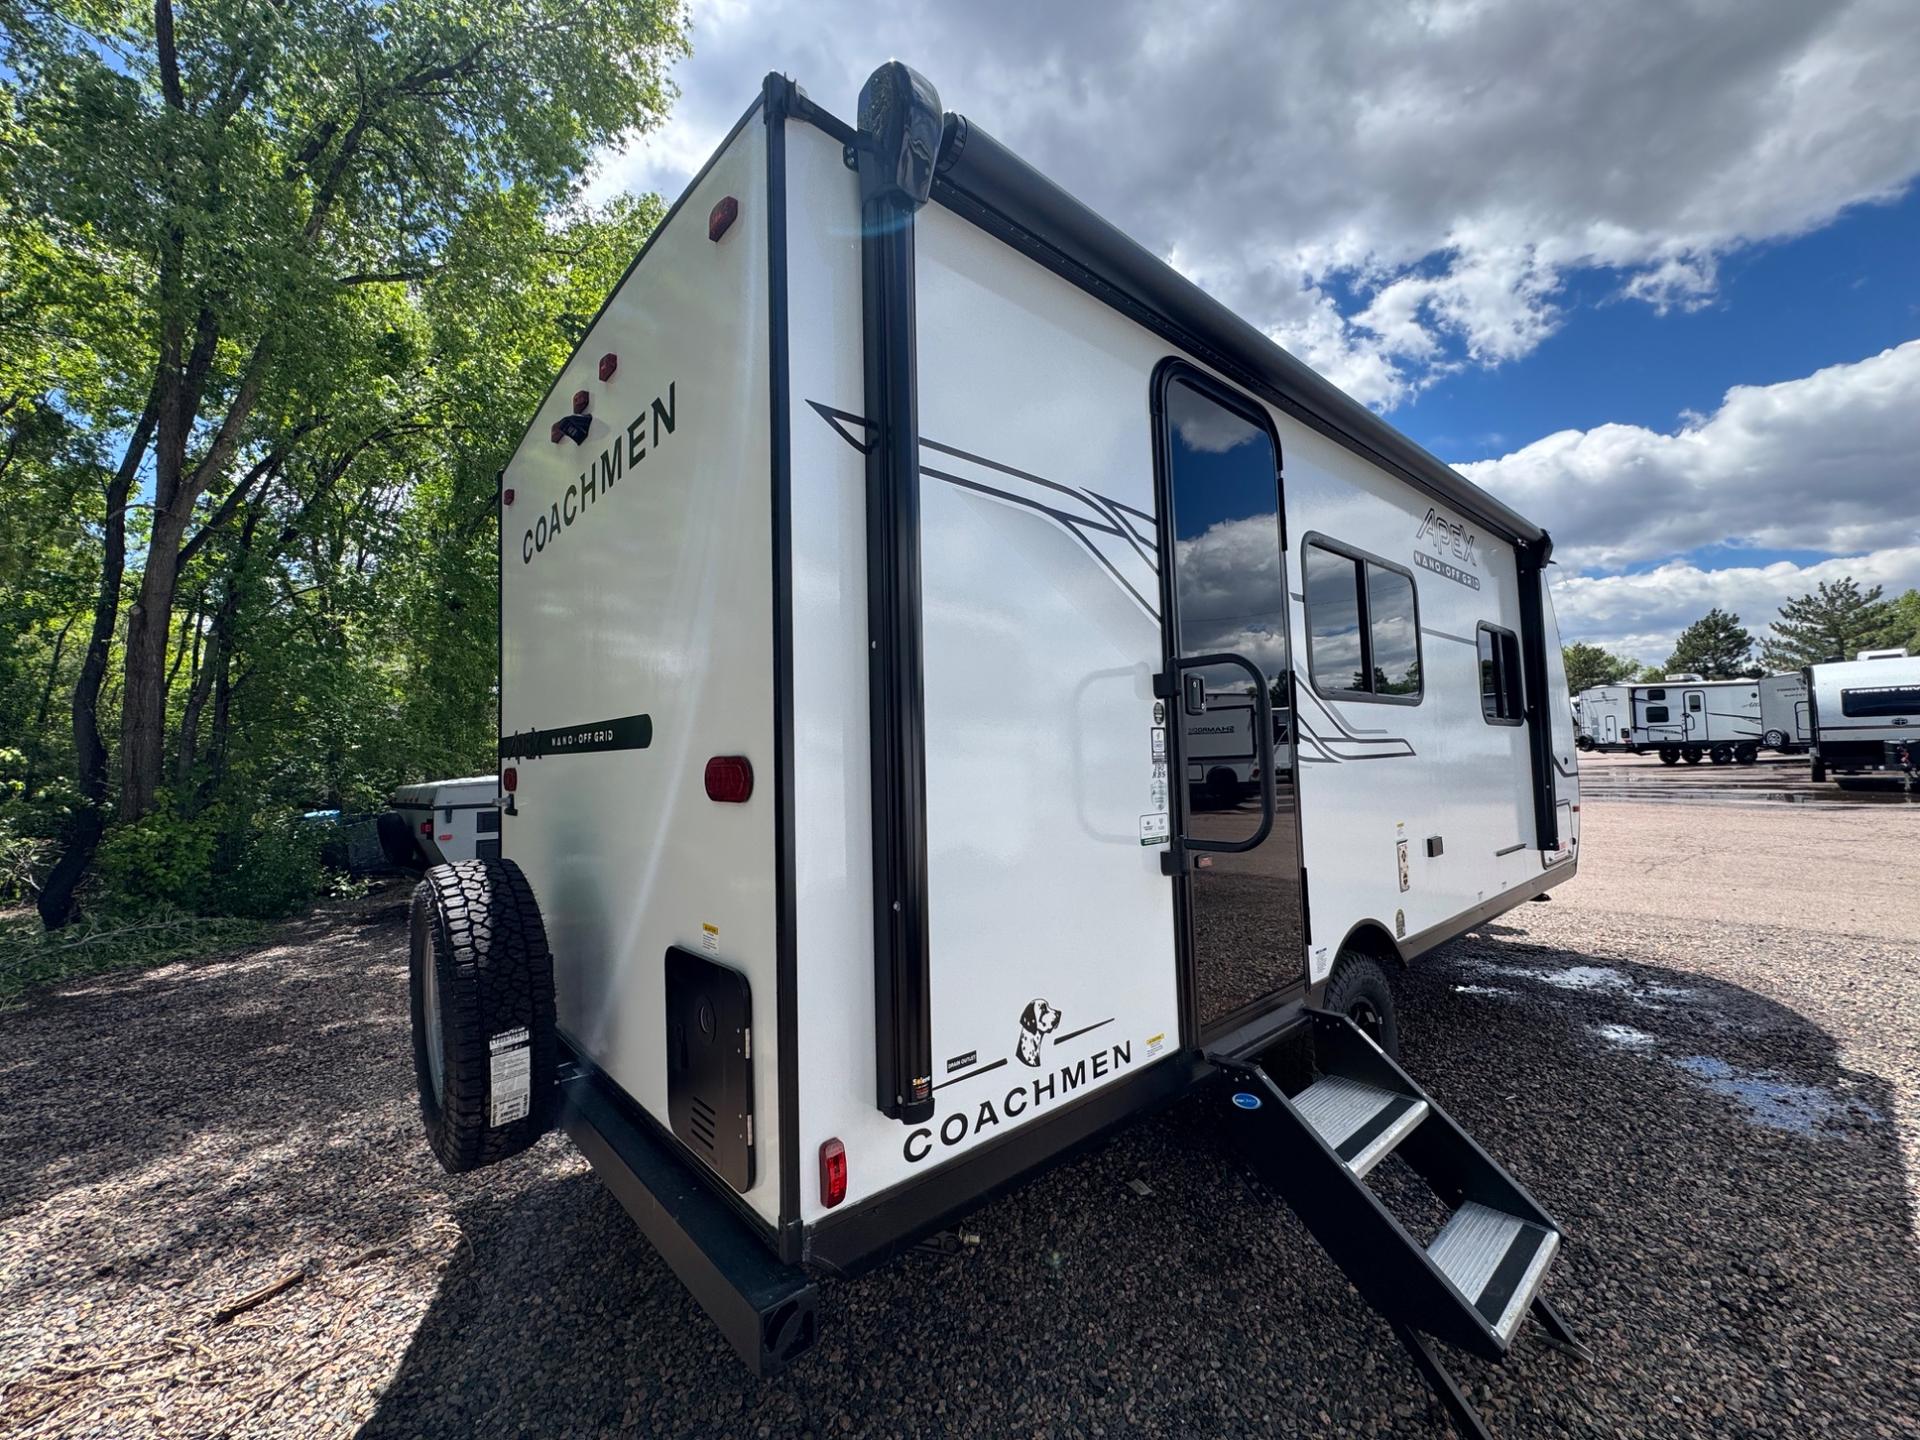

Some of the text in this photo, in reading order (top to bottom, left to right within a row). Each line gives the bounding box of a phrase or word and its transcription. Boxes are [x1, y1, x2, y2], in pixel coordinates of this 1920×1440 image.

[522, 380, 676, 565] COACHMEN
[1415, 507, 1477, 567] APEX
[551, 735, 573, 746] NANO
[578, 732, 592, 744] OFF
[593, 729, 614, 742] GRID
[903, 1040, 1132, 1163] COACHMEN
